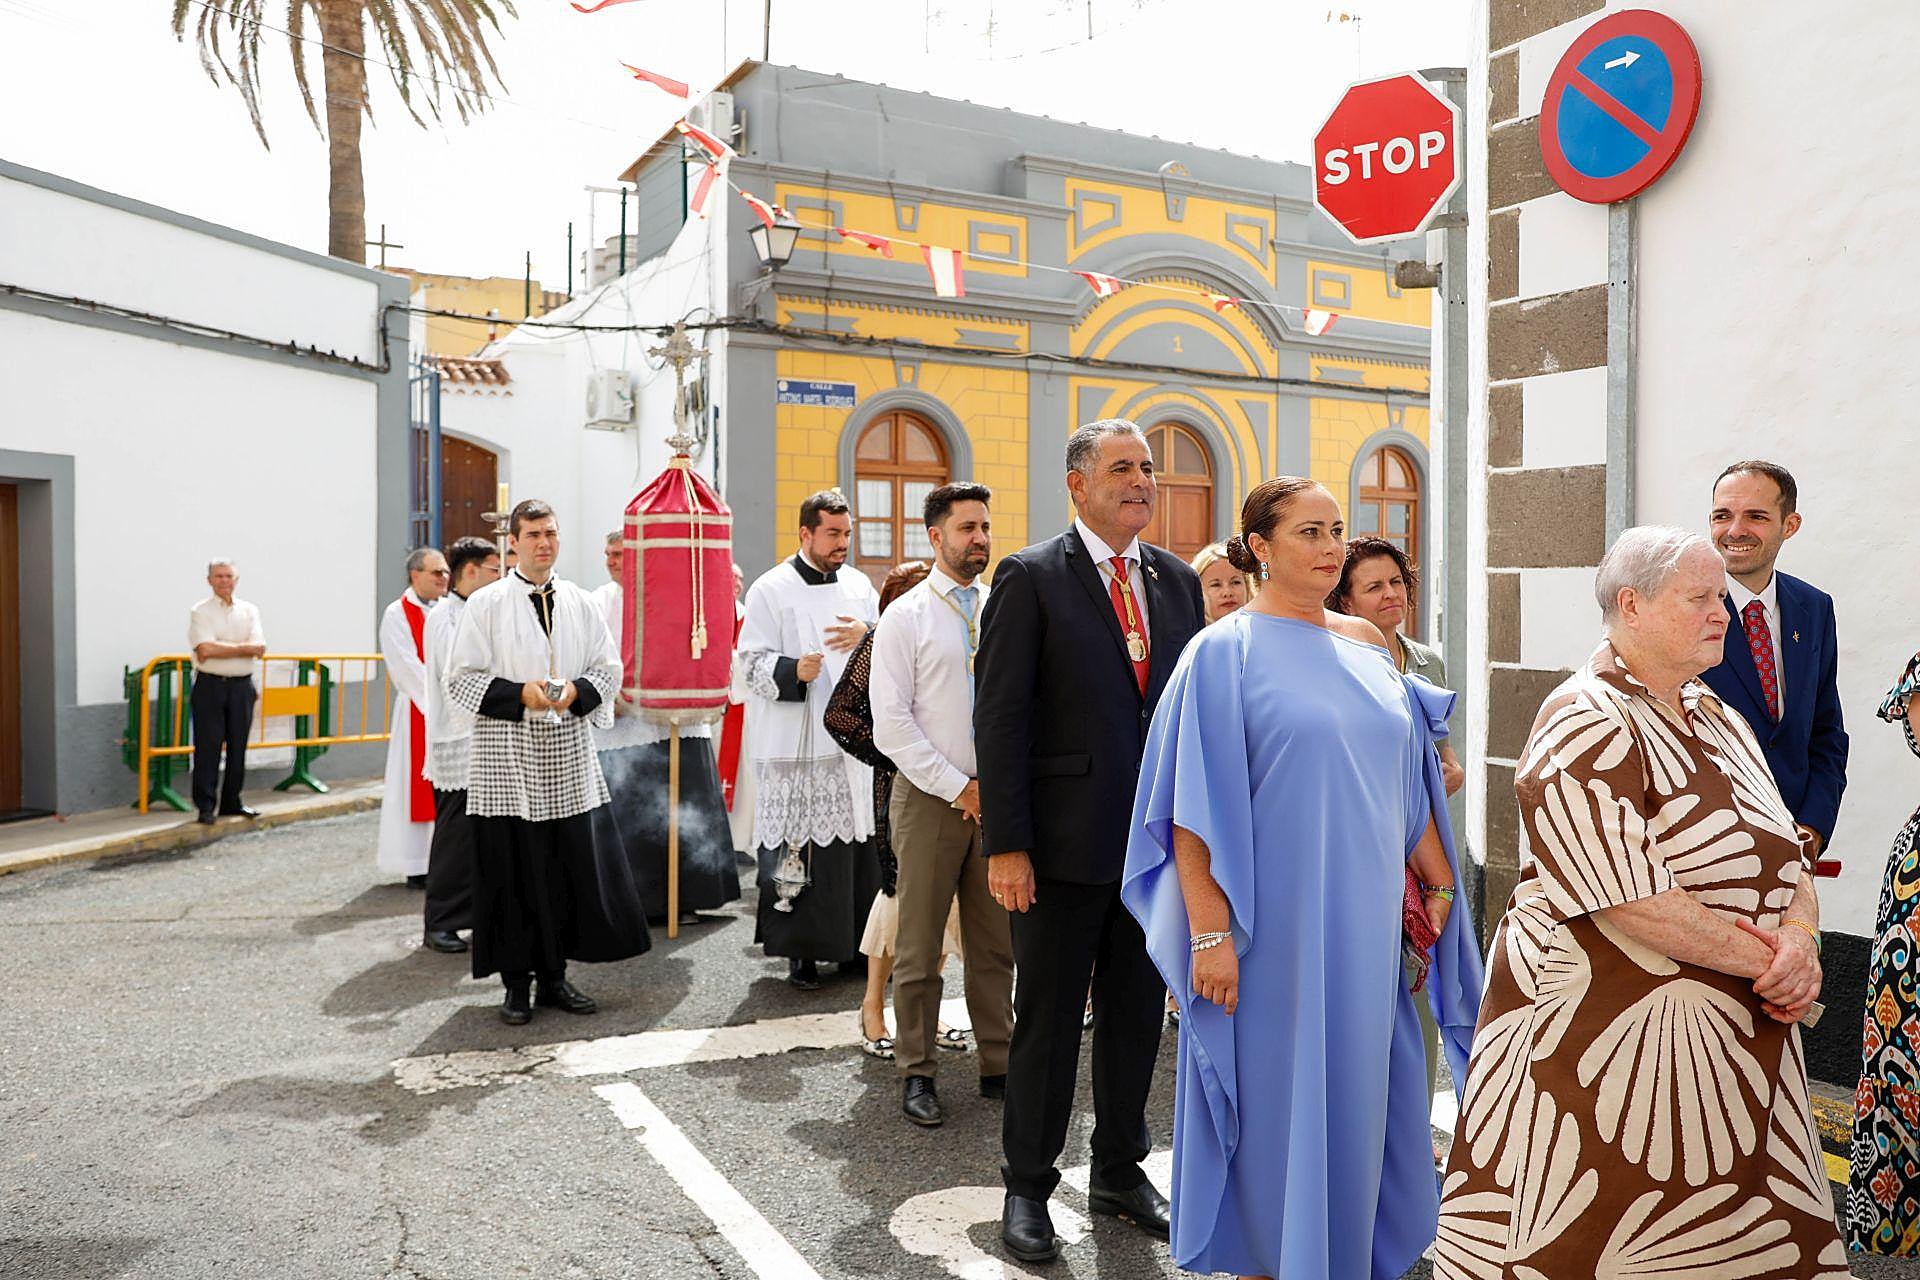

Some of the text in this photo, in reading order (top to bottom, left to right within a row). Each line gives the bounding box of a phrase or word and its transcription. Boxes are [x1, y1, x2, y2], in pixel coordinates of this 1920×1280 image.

[1323, 131, 1446, 185] STOP
[1173, 336, 1184, 352] 1
[809, 383, 833, 391] CALLE
